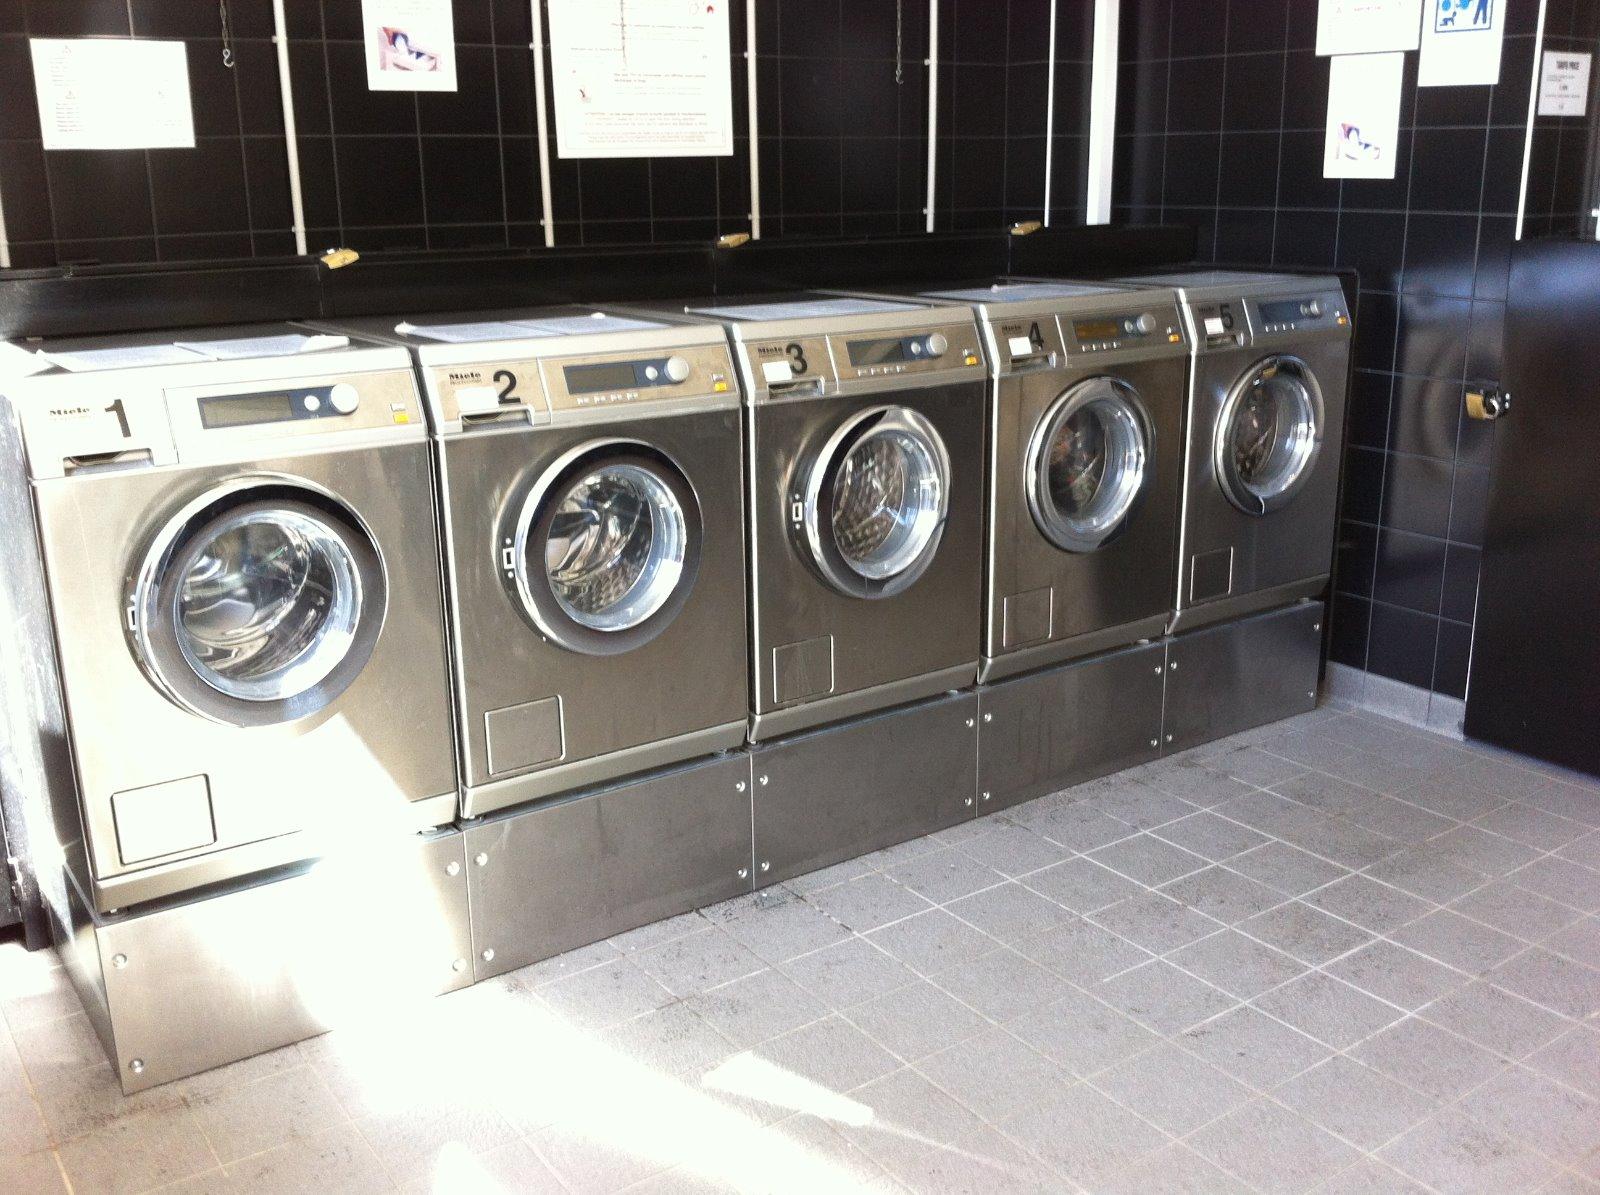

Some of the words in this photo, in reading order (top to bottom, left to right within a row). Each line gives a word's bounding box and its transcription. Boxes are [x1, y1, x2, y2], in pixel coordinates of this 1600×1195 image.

[1219, 303, 1234, 330] 5
[1028, 321, 1044, 349] 4
[758, 346, 783, 354] Miele
[785, 343, 808, 374] 3
[449, 371, 482, 381] Miele
[492, 369, 521, 405] 2
[49, 406, 90, 416] Miele
[104, 398, 131, 438] 1
